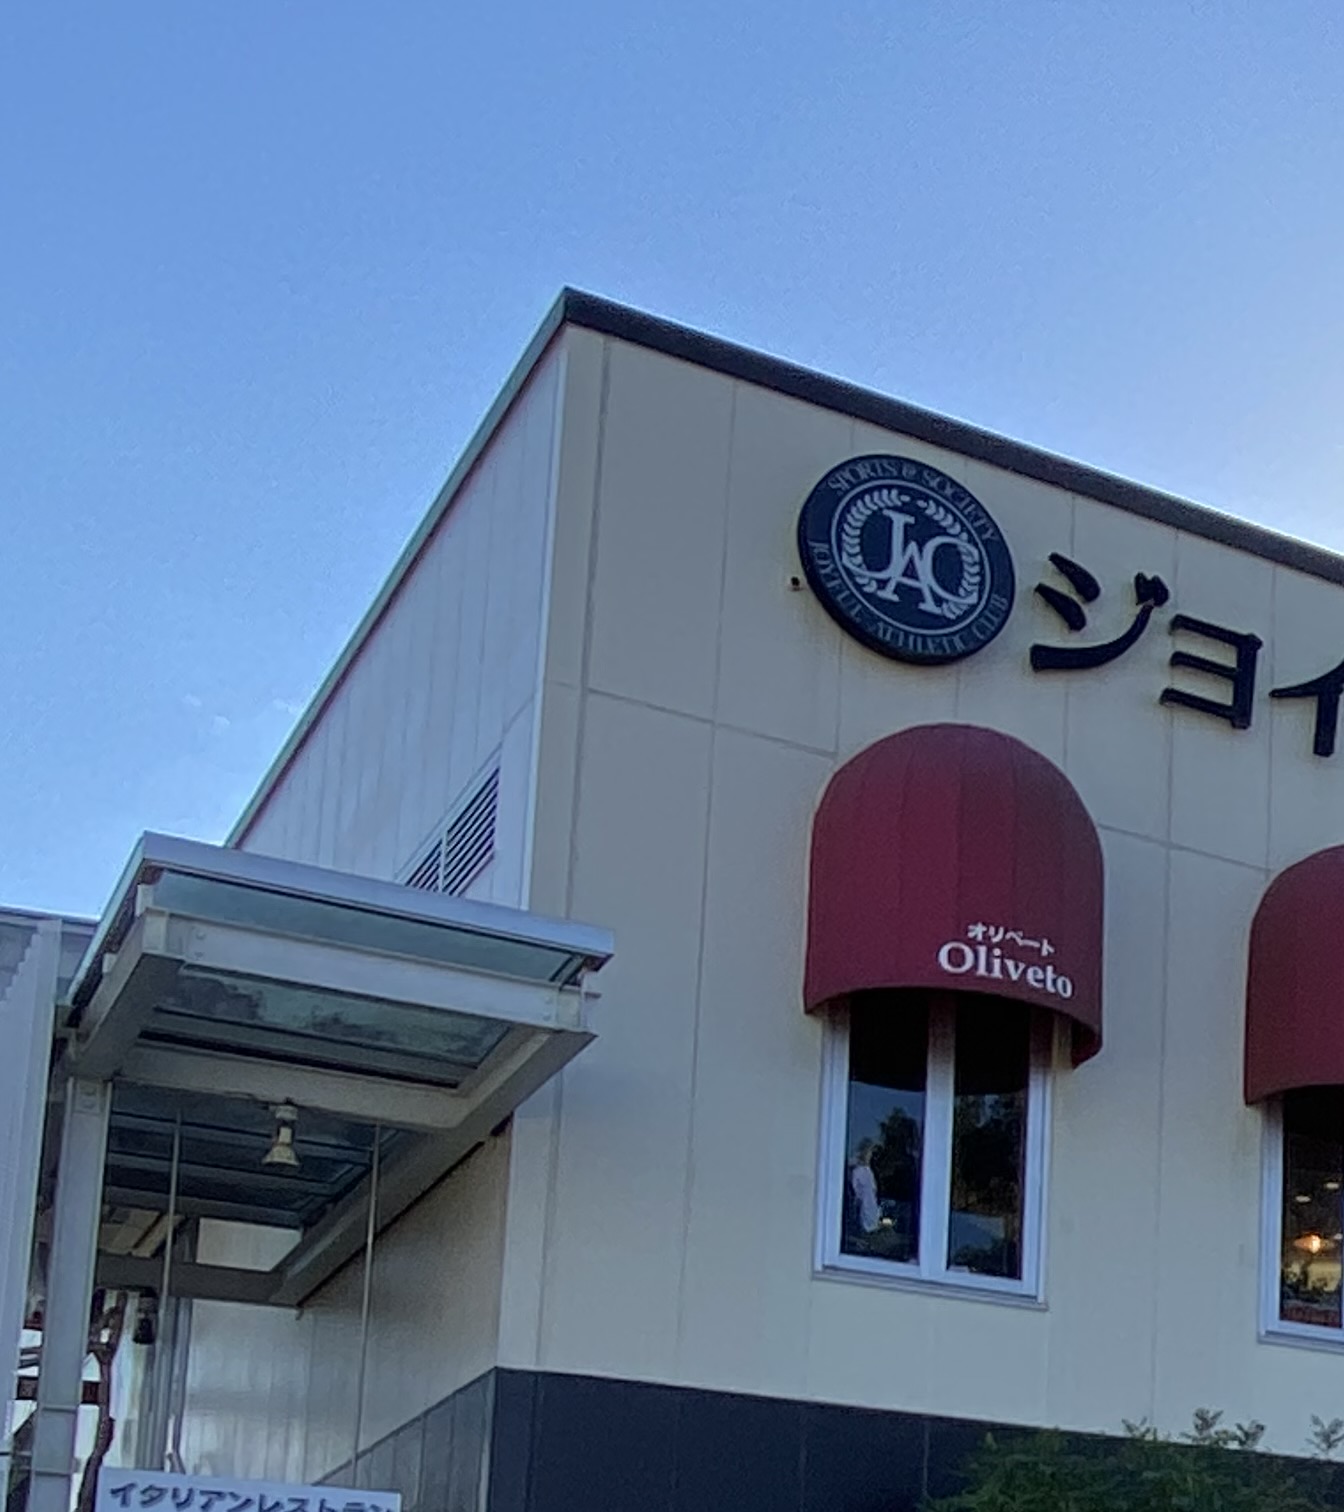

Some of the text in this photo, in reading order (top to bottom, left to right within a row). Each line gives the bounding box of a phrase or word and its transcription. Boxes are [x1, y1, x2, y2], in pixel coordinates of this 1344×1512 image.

[966, 921, 1055, 957] オリベート
[937, 940, 1074, 999] Oliveto
